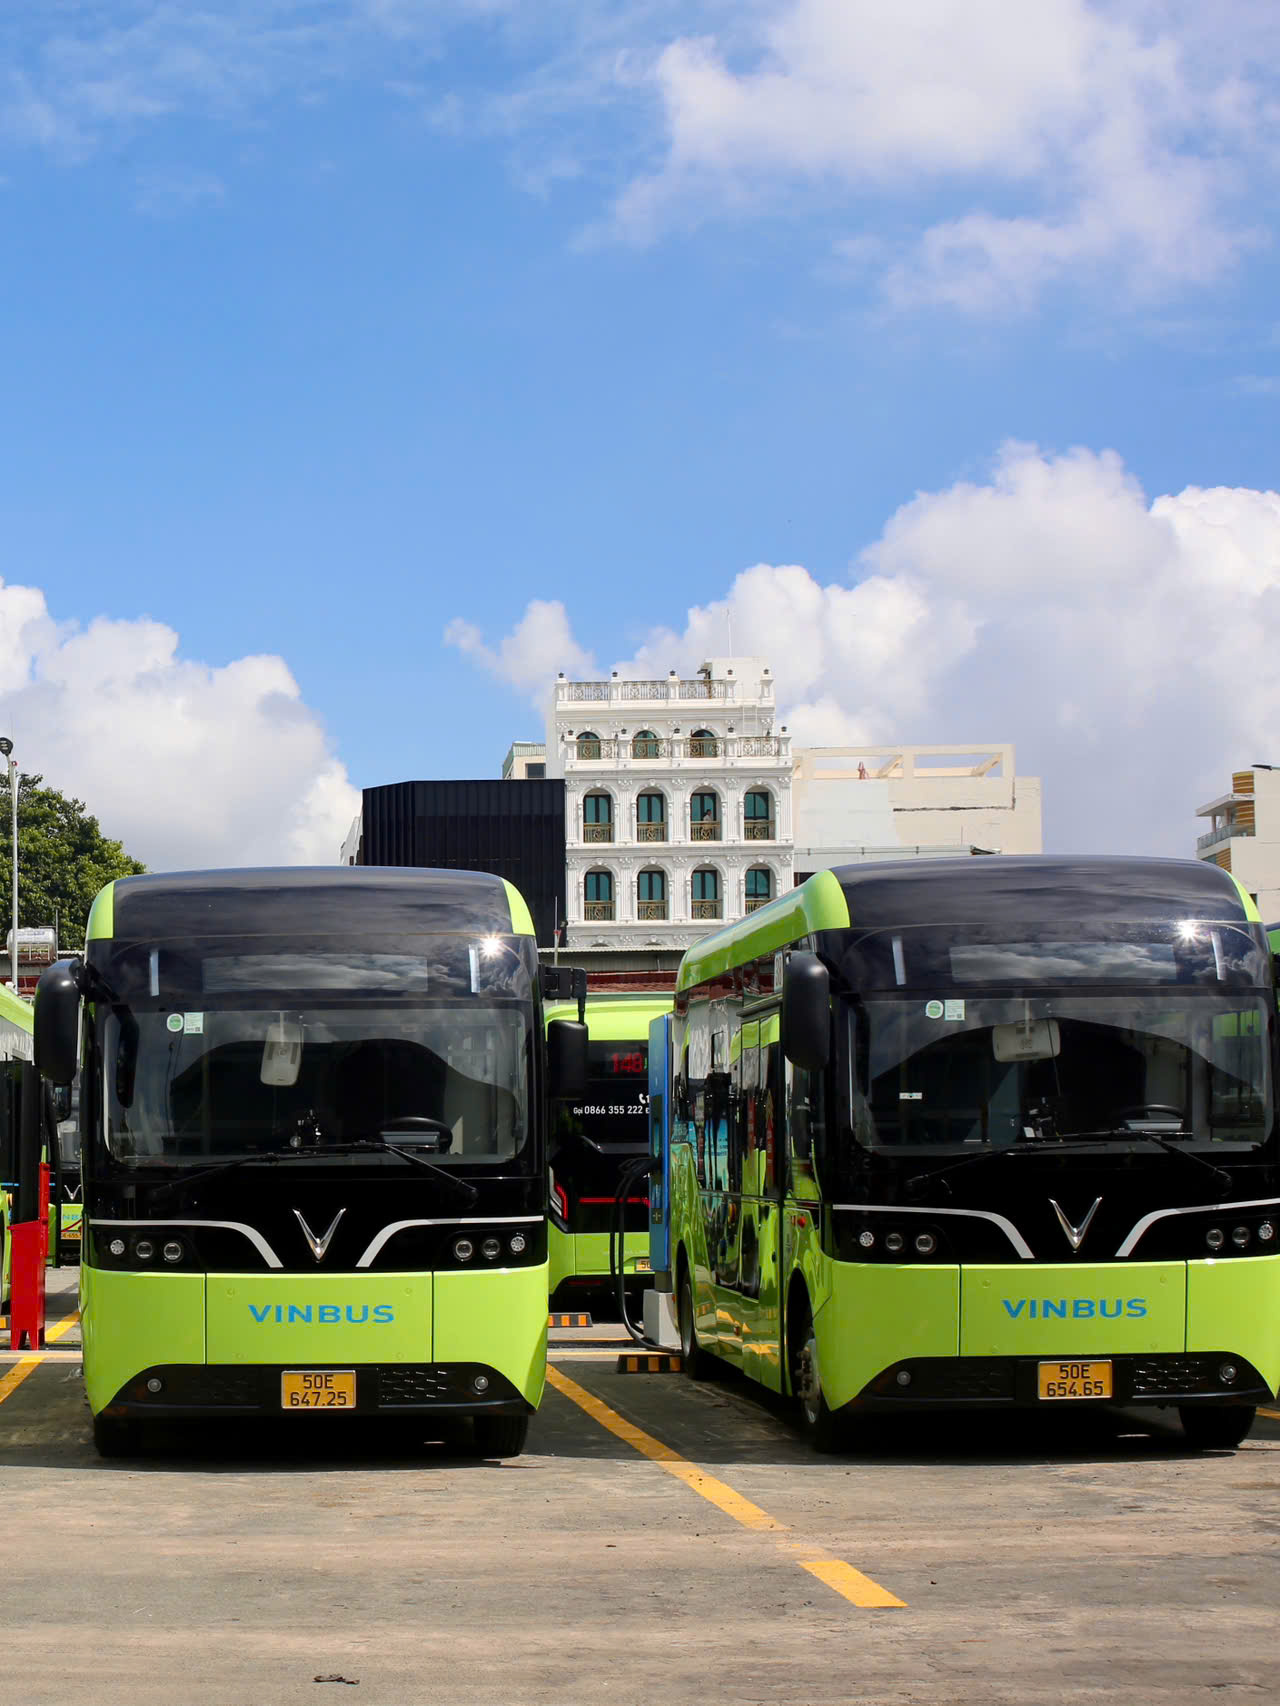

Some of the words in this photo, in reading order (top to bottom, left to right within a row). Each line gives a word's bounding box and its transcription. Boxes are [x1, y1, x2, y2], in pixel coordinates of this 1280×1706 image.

[611, 1052, 644, 1073] 148
[573, 1107, 583, 1116] Gọi
[584, 1106, 606, 1114] 0866
[608, 1106, 625, 1114] 355
[627, 1106, 643, 1114] 222
[248, 1303, 395, 1324] VINBUS
[1002, 1298, 1148, 1319] VINBUS
[1060, 1364, 1091, 1379] 50E
[303, 1374, 334, 1389] 50E
[1047, 1381, 1104, 1397] 654.65
[290, 1391, 347, 1406] 647.25
